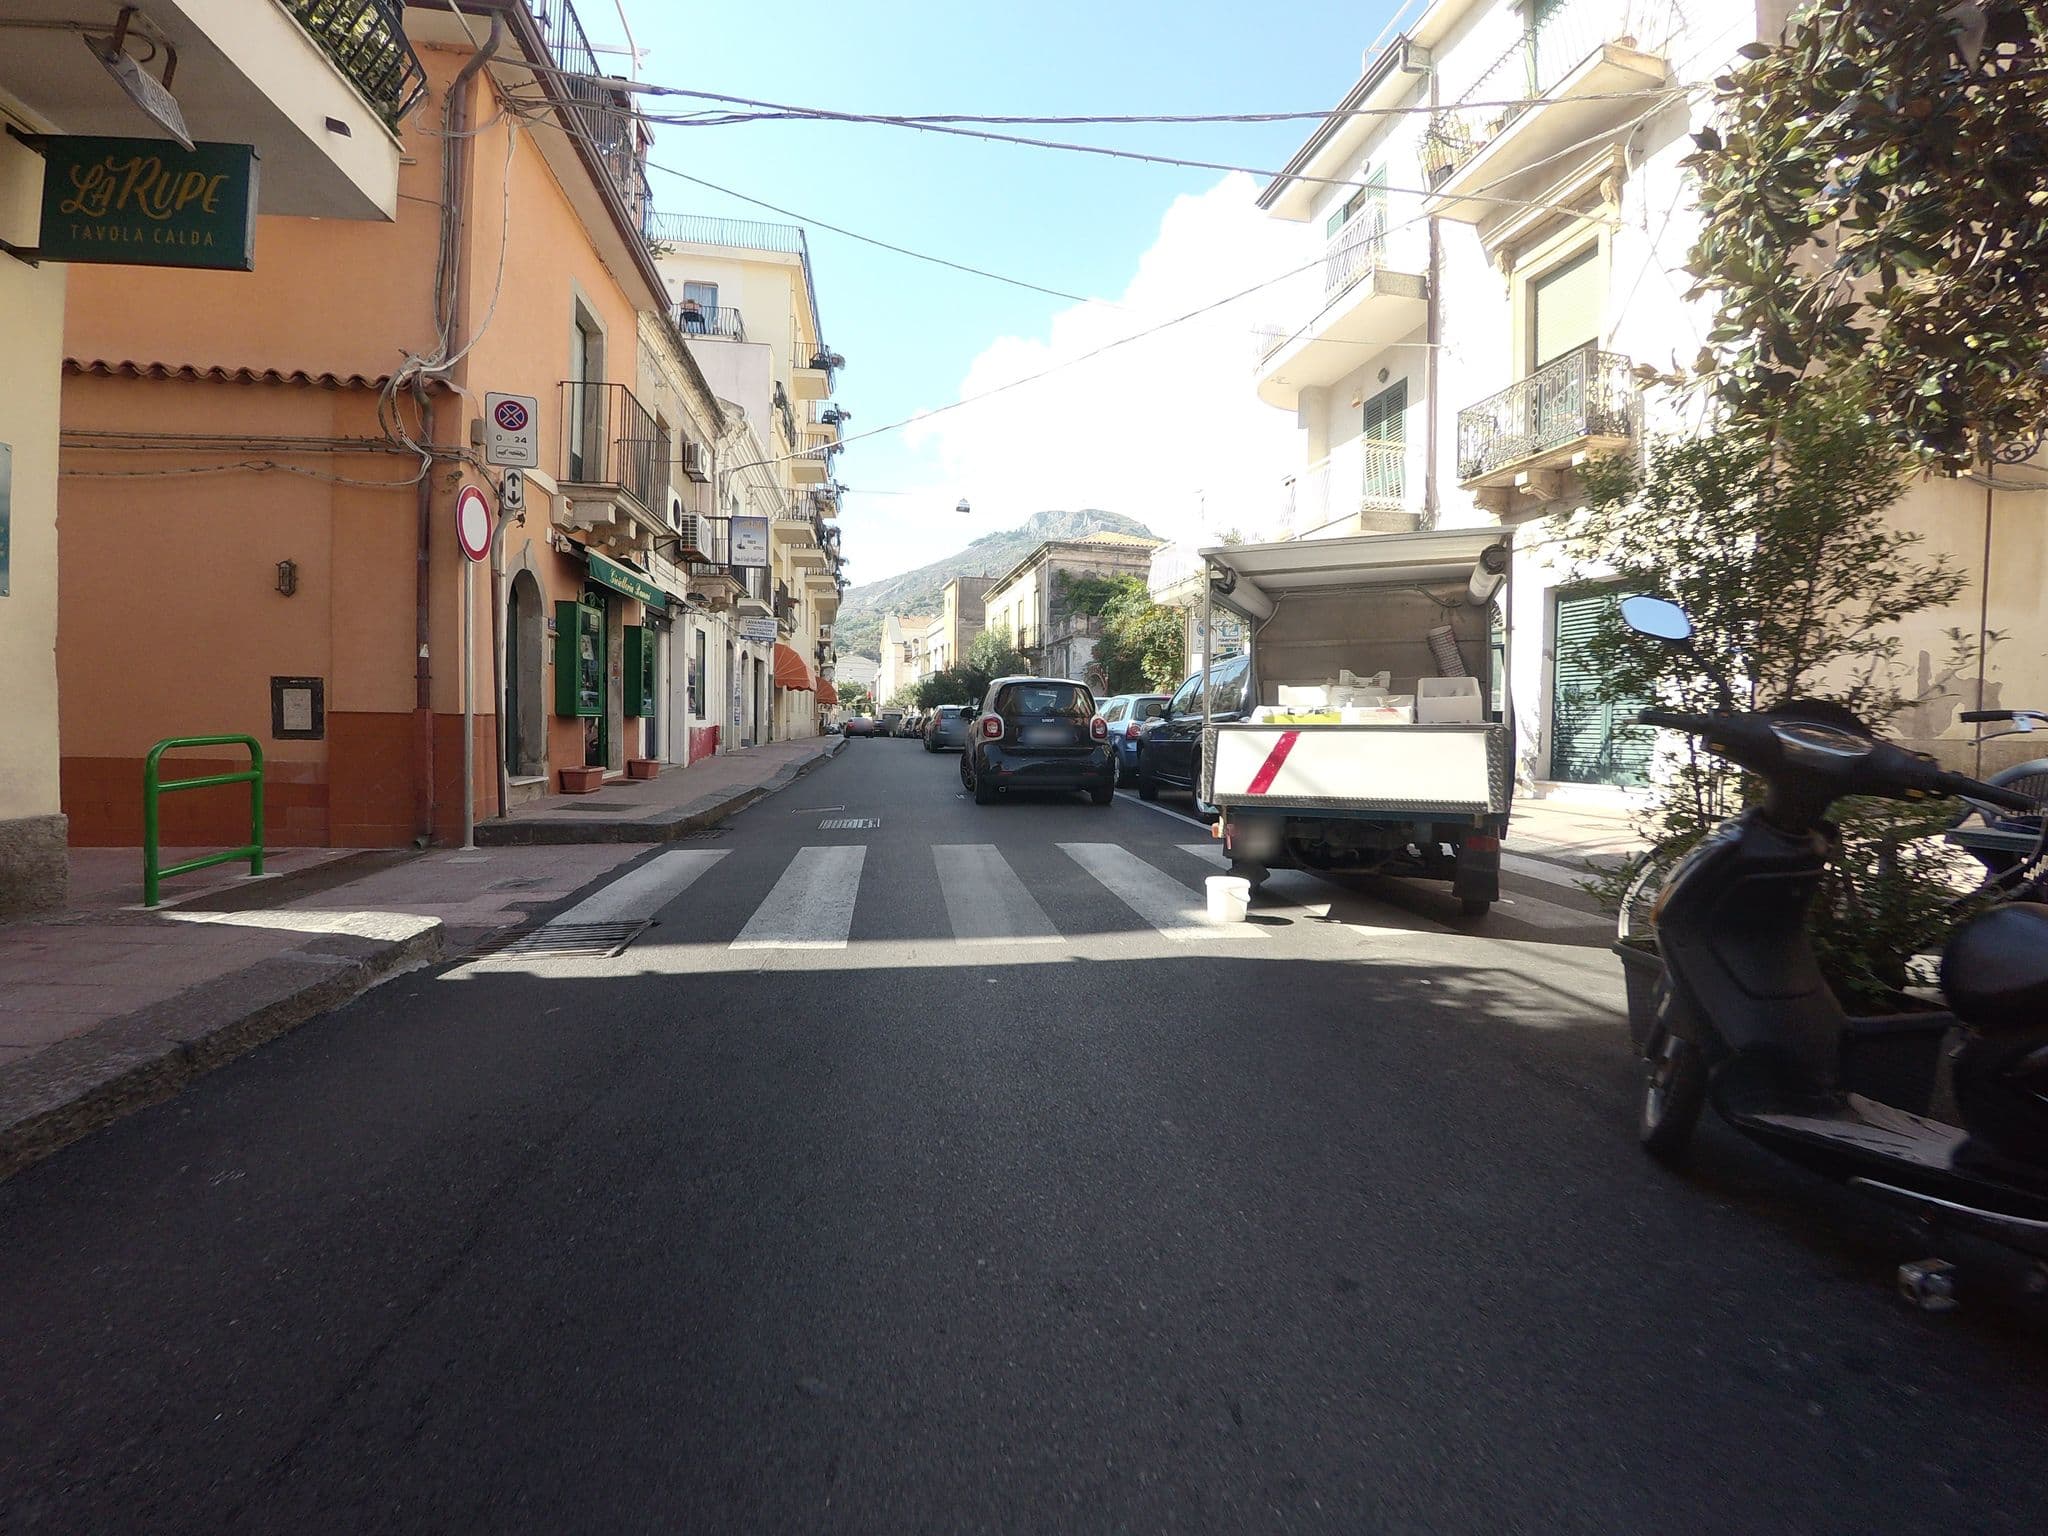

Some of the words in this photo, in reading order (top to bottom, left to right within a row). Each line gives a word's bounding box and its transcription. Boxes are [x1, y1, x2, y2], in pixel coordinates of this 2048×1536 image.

[107, 155, 229, 220] RUPE
[71, 224, 144, 243] TAVOLA
[153, 227, 215, 246] CALDA
[514, 436, 527, 444] 24
